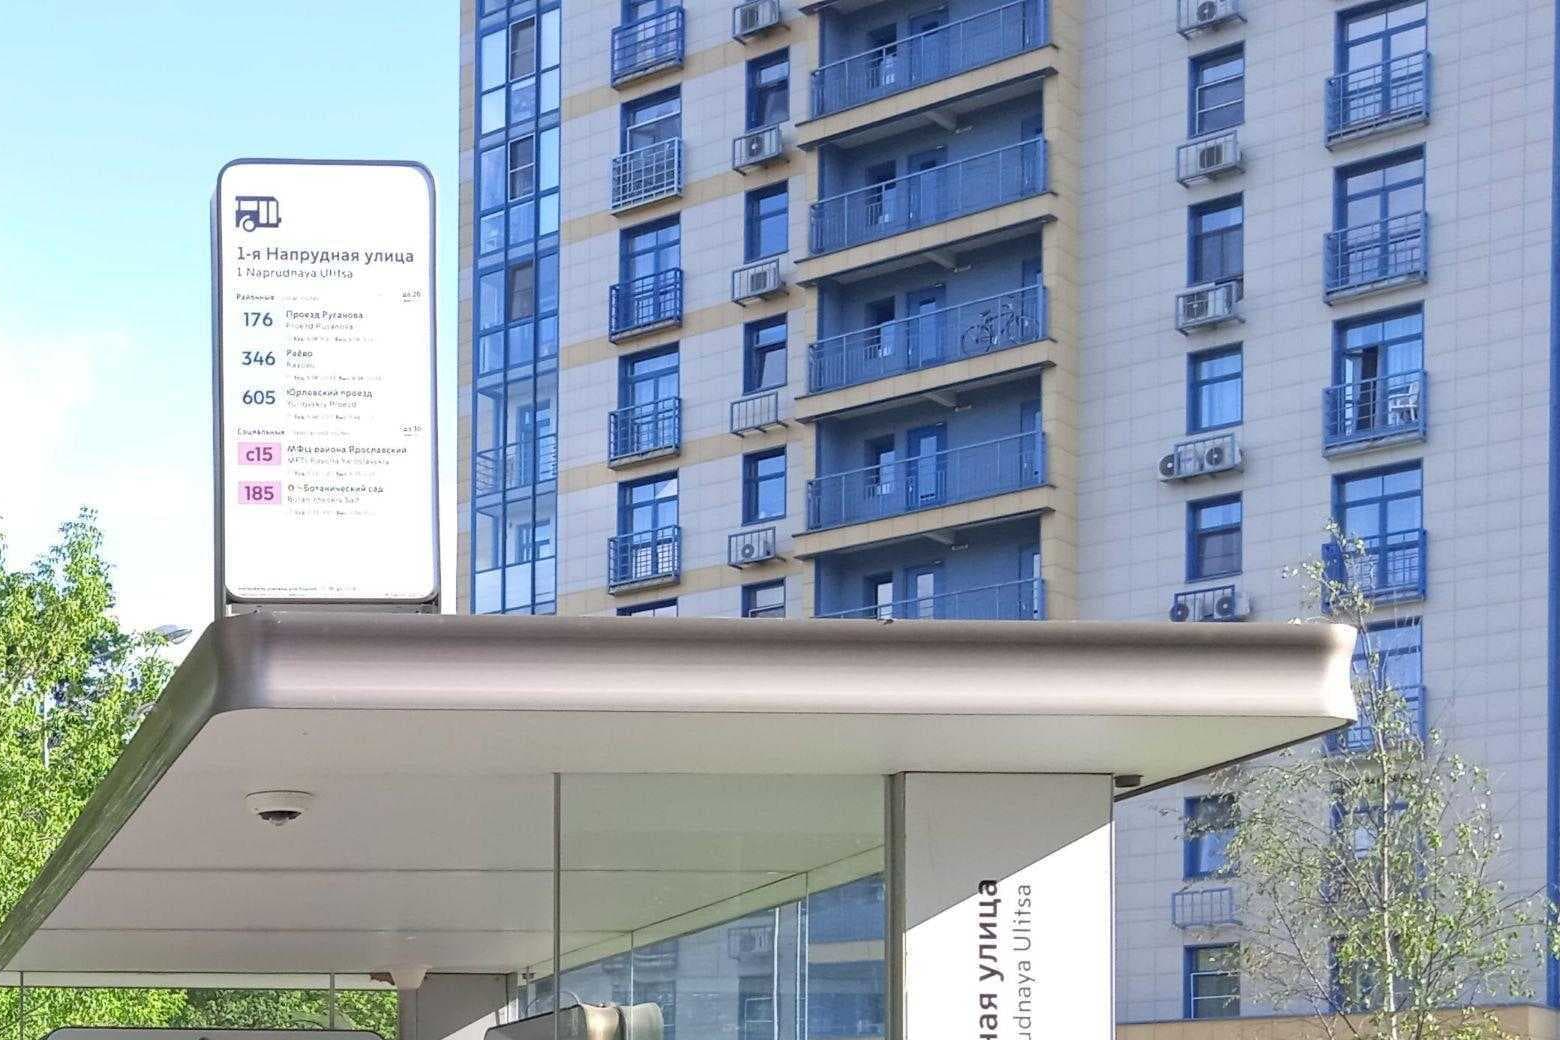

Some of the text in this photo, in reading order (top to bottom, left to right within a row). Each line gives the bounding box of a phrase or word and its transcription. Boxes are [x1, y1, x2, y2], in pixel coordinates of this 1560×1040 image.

[237, 246, 414, 266] 1-я Напрудная улица
[237, 267, 243, 278] 1
[246, 267, 317, 280] Naprudnaya
[243, 312, 273, 328] 176
[241, 351, 276, 366] 346
[242, 389, 276, 406] 605
[244, 486, 275, 502] 185
[1013, 884, 1032, 952] Ulitsa
[978, 879, 1004, 982] улица
